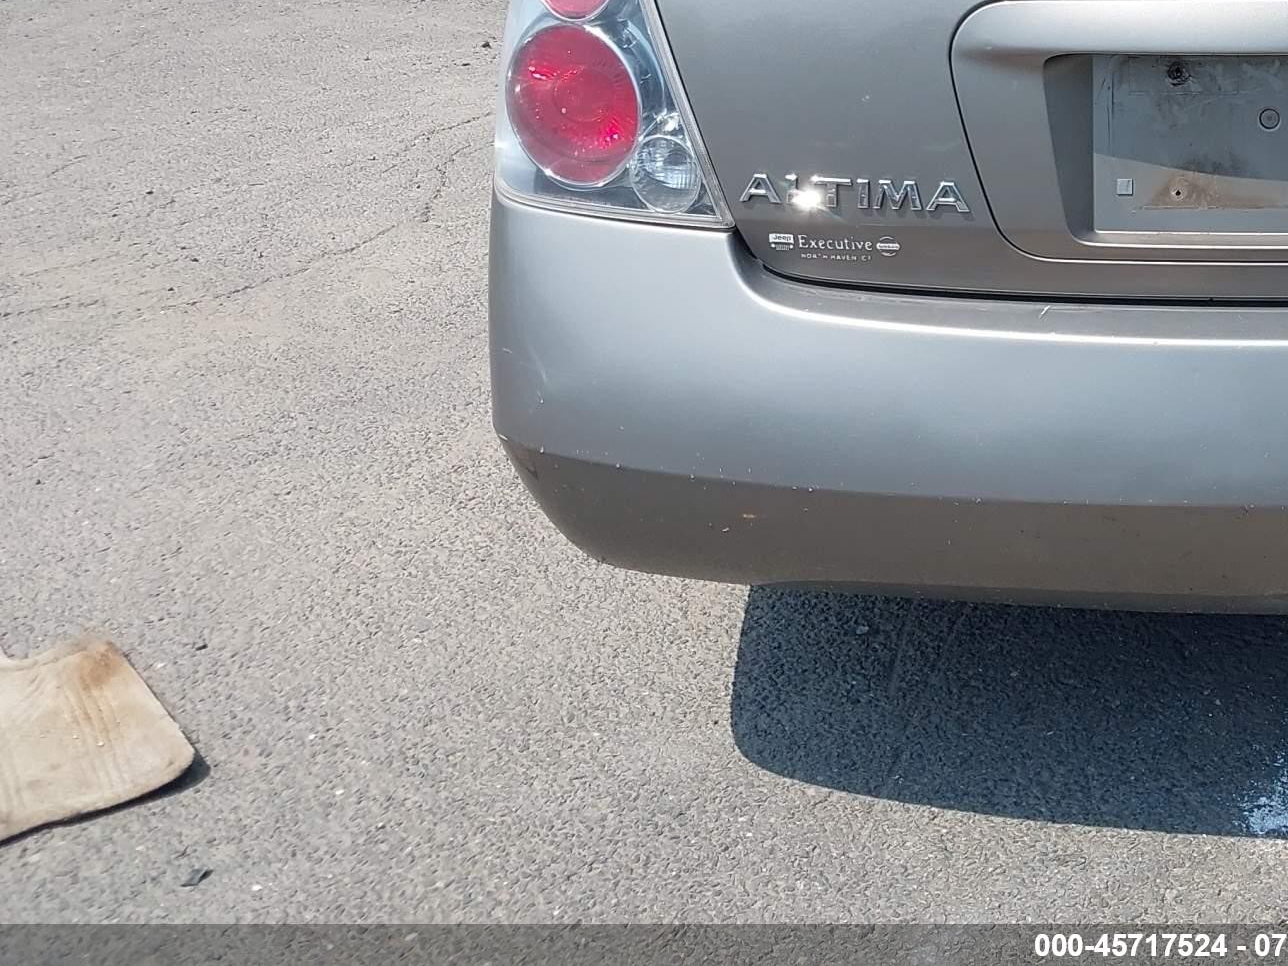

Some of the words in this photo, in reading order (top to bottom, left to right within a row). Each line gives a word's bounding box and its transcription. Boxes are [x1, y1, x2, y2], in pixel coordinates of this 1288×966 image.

[739, 173, 970, 213] ALTIMA
[772, 234, 792, 242] Jeep
[797, 234, 873, 251] Executive
[830, 254, 858, 262] HAVEN
